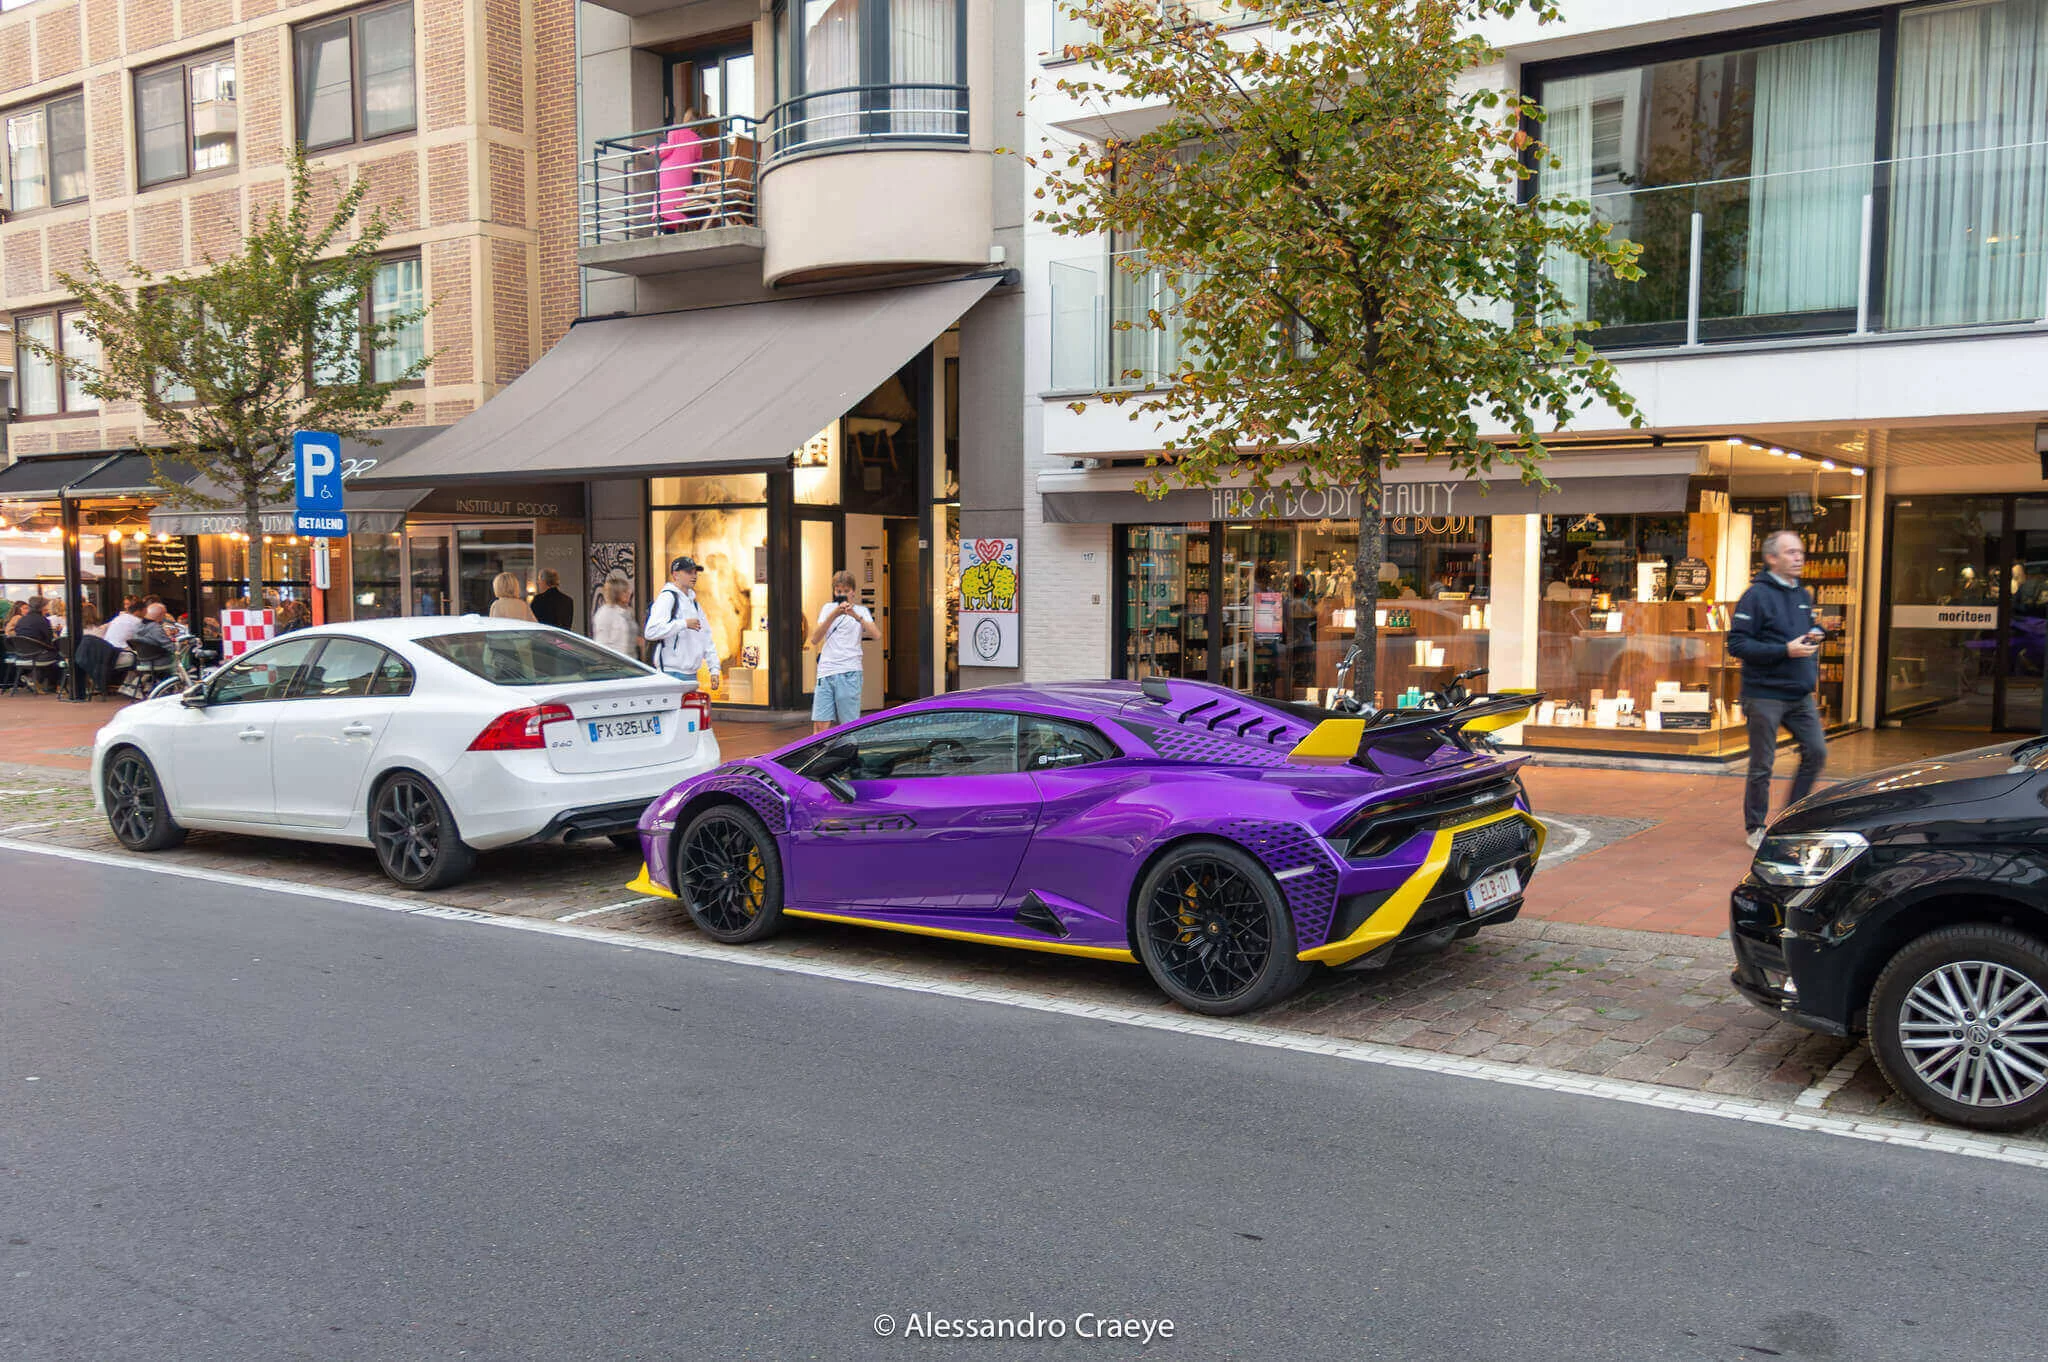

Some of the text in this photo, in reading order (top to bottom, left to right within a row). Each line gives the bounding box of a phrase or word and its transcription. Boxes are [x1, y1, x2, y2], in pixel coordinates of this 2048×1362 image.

[302, 443, 335, 497] P
[456, 500, 558, 515] INSTITUUT PODOR
[1212, 488, 1253, 519] HAIR
[1382, 482, 1459, 515] EAUTY
[202, 516, 241, 532] PODOR
[298, 517, 344, 530] BETALEND
[592, 698, 668, 710] VOLVO
